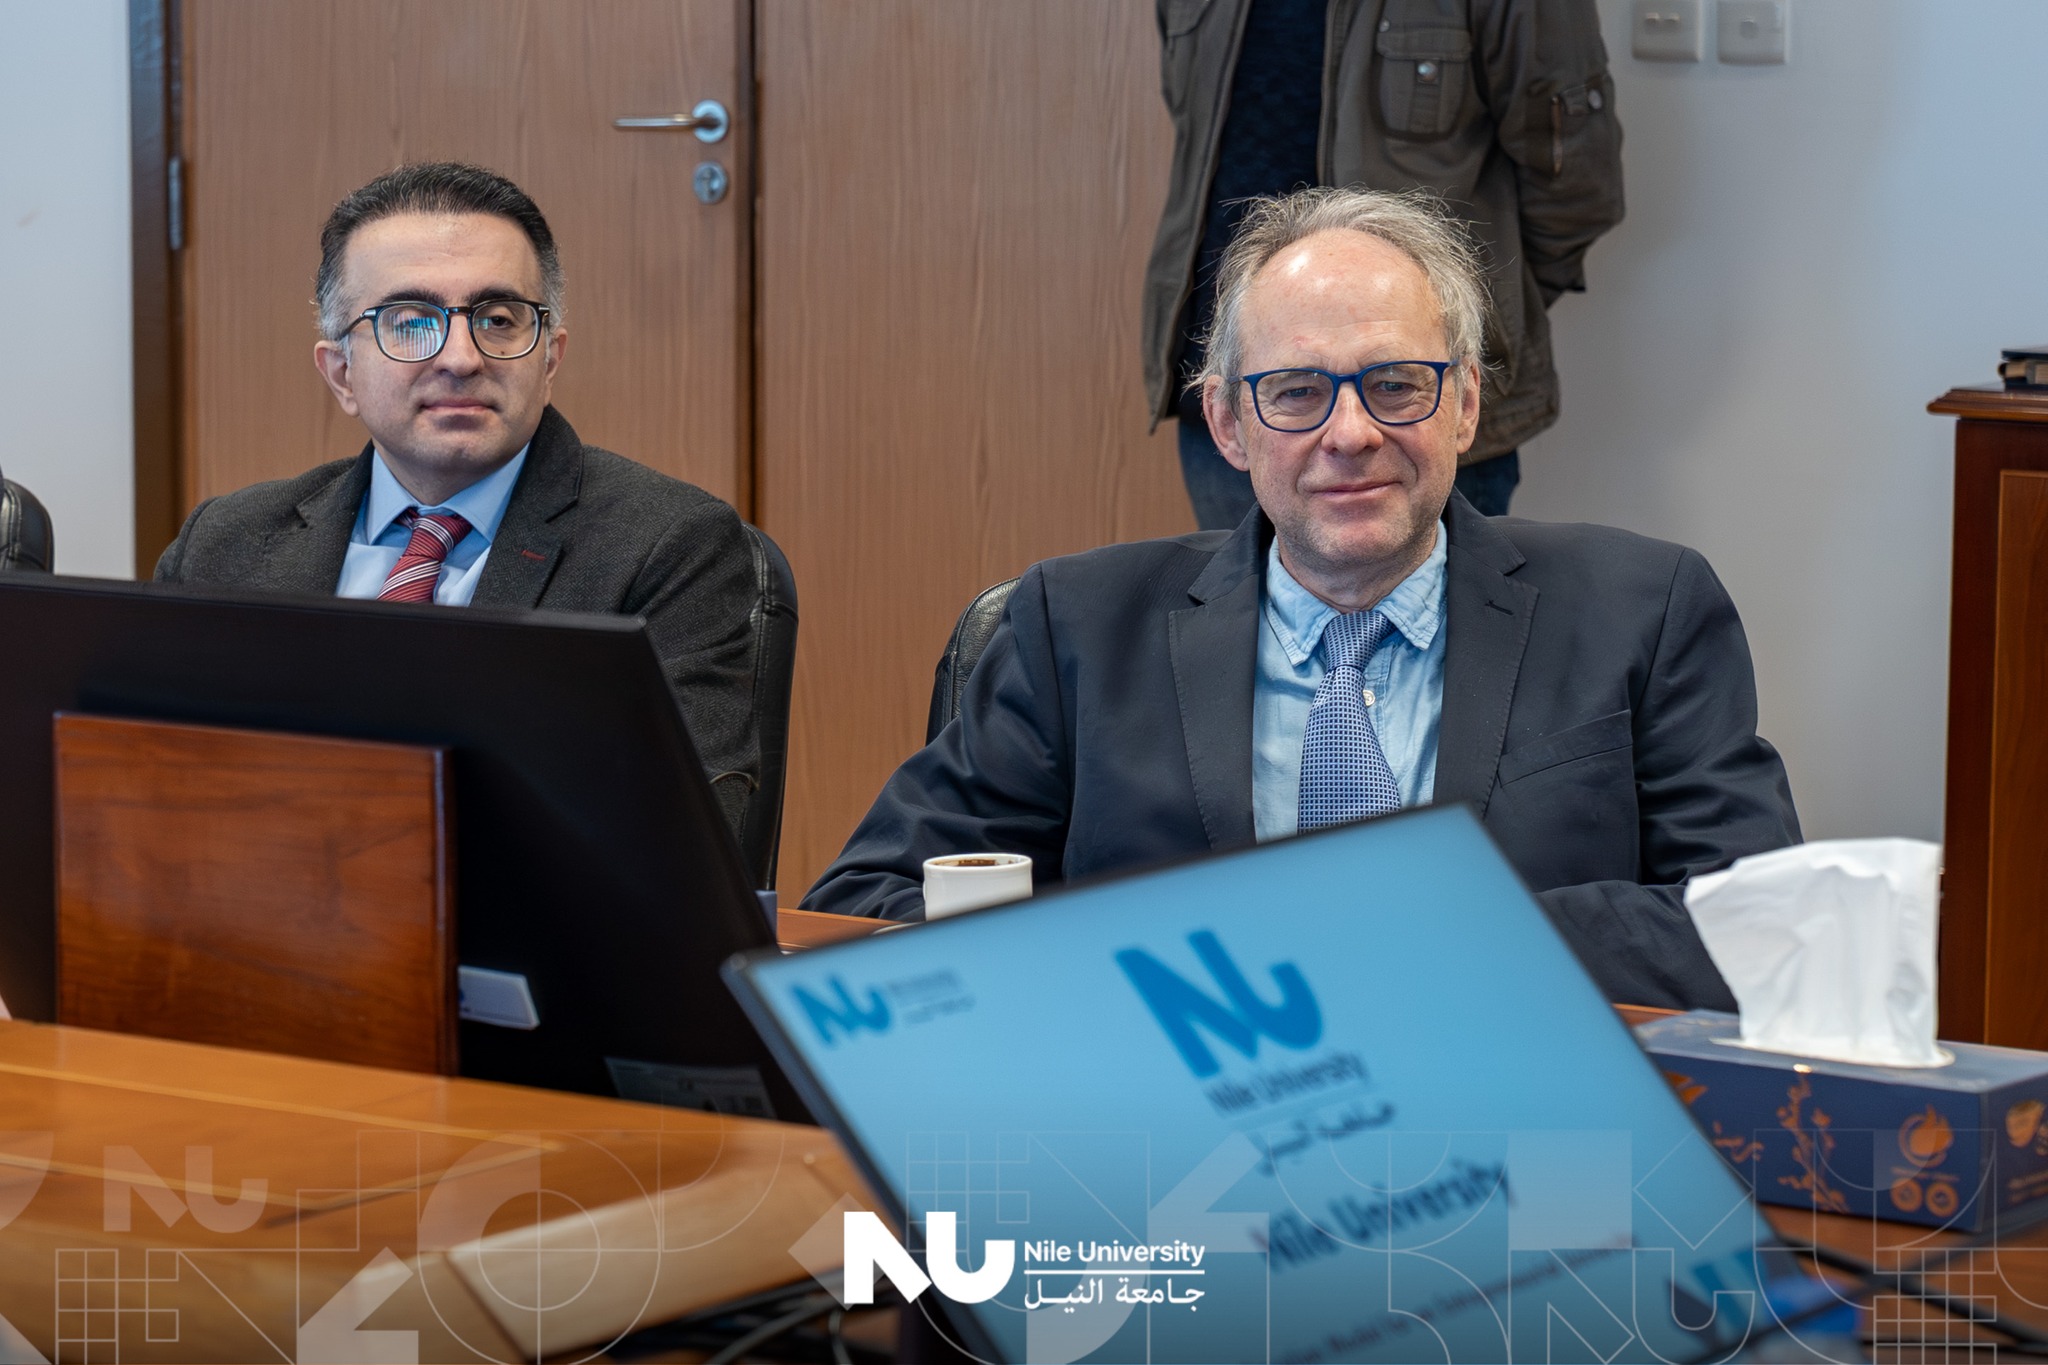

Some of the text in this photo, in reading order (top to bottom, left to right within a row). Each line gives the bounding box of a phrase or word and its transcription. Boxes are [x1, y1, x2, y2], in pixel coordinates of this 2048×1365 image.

[1114, 928, 1324, 1080] NU
[1250, 1158, 1517, 1272] Nile University
